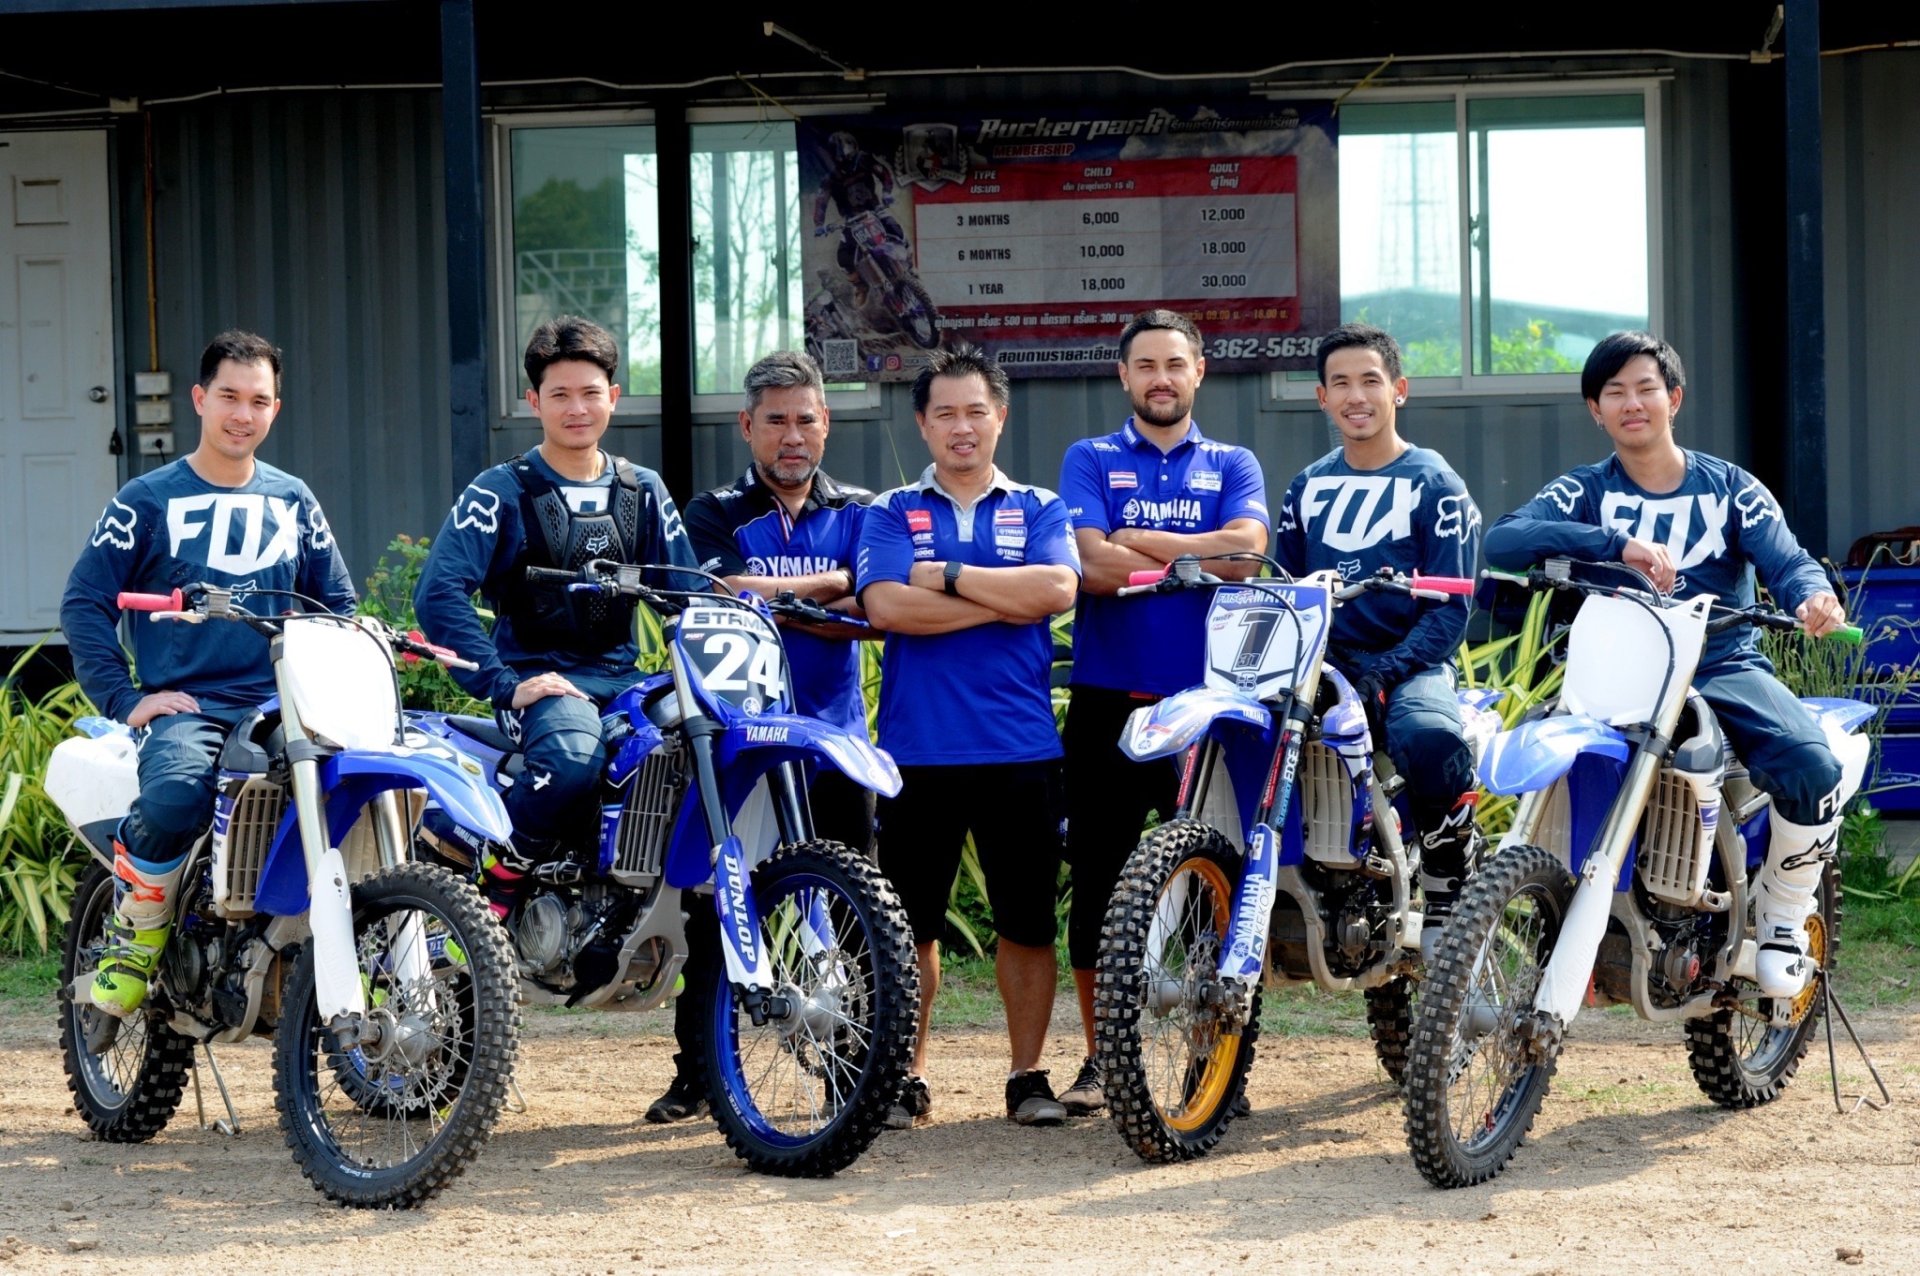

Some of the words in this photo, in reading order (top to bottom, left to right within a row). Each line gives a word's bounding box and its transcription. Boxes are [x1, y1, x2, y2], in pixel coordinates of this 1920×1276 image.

[993, 143, 1075, 158] MEMBERSHIP
[974, 170, 996, 180] TYPE
[1084, 167, 1112, 177] CHILD
[1209, 163, 1239, 173] ADULT
[957, 216, 964, 226] 3
[968, 214, 1010, 226] MONTHS
[1082, 211, 1120, 225] 6,000
[1201, 207, 1245, 222] 12,000
[958, 249, 965, 260] 6
[969, 247, 1011, 261] MONTHS
[1080, 244, 1125, 259] 10,000
[1202, 240, 1246, 255] 18,000
[968, 284, 972, 294] 1
[977, 282, 1004, 295] YEAR
[1081, 277, 1125, 292] 18,000
[1201, 274, 1246, 289] 30,000
[1004, 316, 1020, 326] 500
[1100, 313, 1117, 323] 300
[1140, 498, 1201, 522] YAMAHA
[1300, 475, 1424, 553] FOX
[1126, 520, 1196, 529] RACING
[1601, 491, 1729, 571] FOX
[167, 493, 299, 576] FOX
[766, 555, 838, 577] YAMAHA
[1232, 607, 1285, 672] 1
[702, 633, 784, 699] 24
[1242, 709, 1264, 724] YAMAHA
[746, 726, 789, 743] YAMAHA
[1283, 749, 1299, 781] EDGE
[725, 854, 757, 963] DUNLOP
[1235, 874, 1263, 940] YAMAHA
